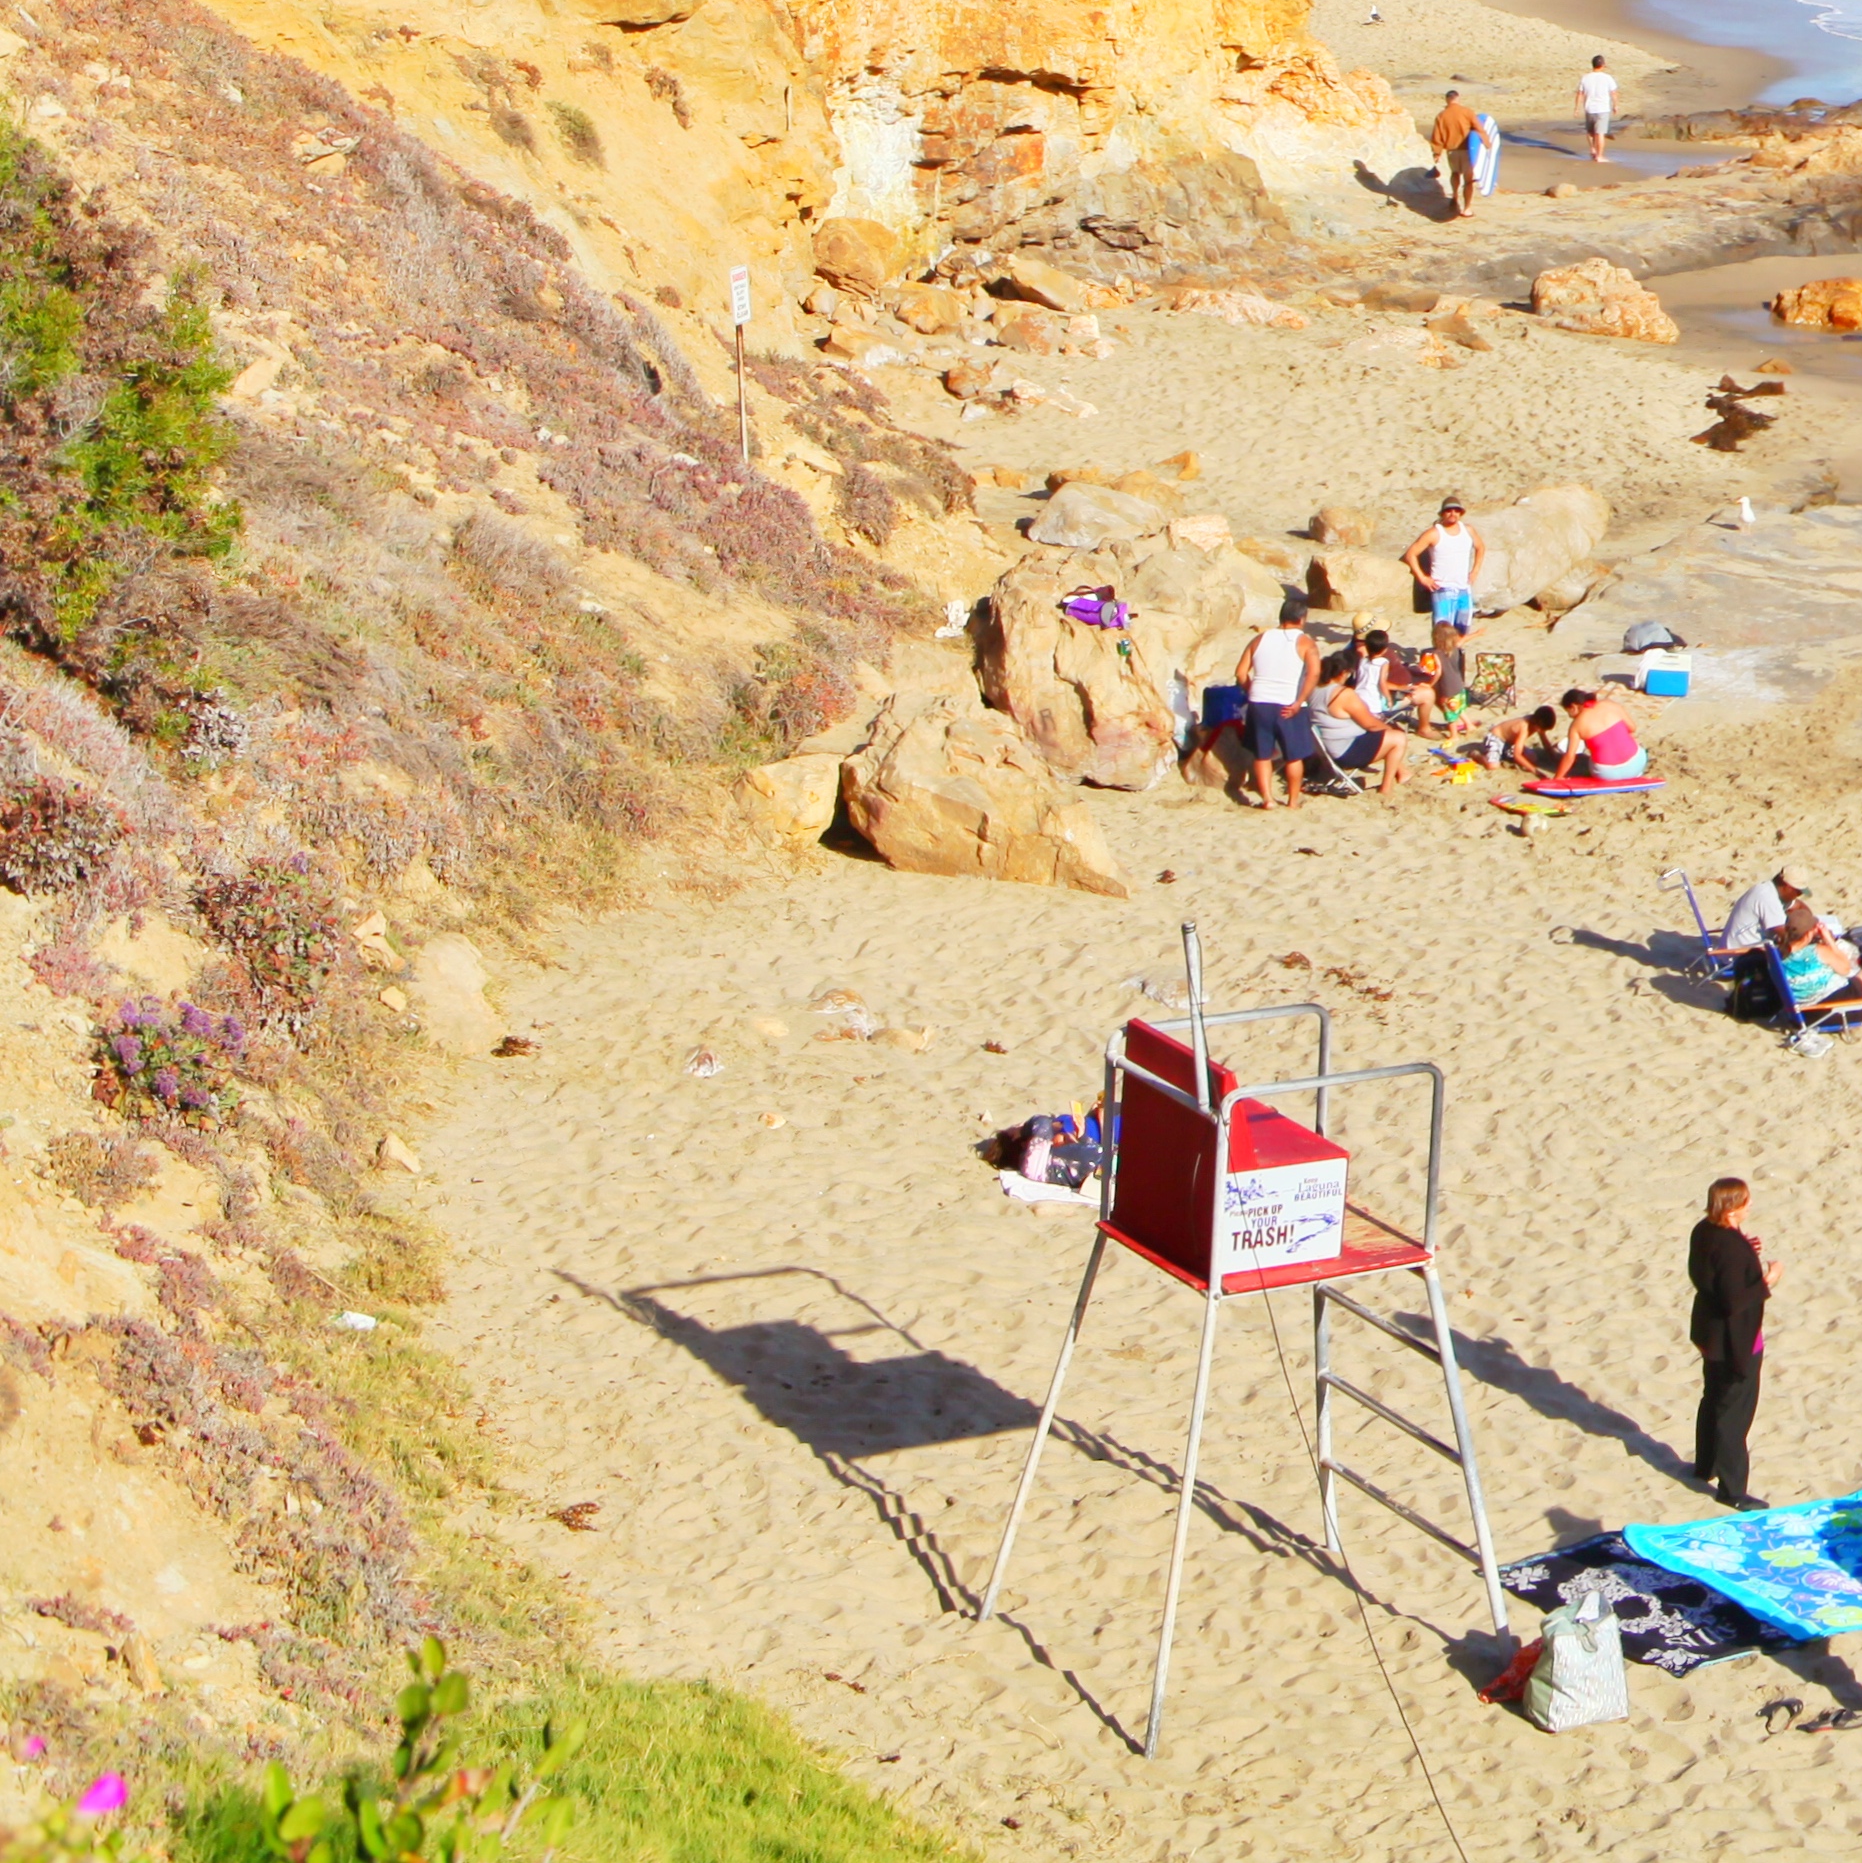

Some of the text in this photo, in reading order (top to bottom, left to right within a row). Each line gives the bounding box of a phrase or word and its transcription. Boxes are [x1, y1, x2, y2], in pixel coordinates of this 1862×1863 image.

[1298, 1180, 1340, 1193] Laguna
[1294, 1188, 1342, 1201] BEAUTIFUL
[1248, 1205, 1269, 1217] PICK
[1271, 1203, 1283, 1215] UP
[1251, 1215, 1278, 1229] YOUR
[1231, 1224, 1294, 1251] TRASH!
